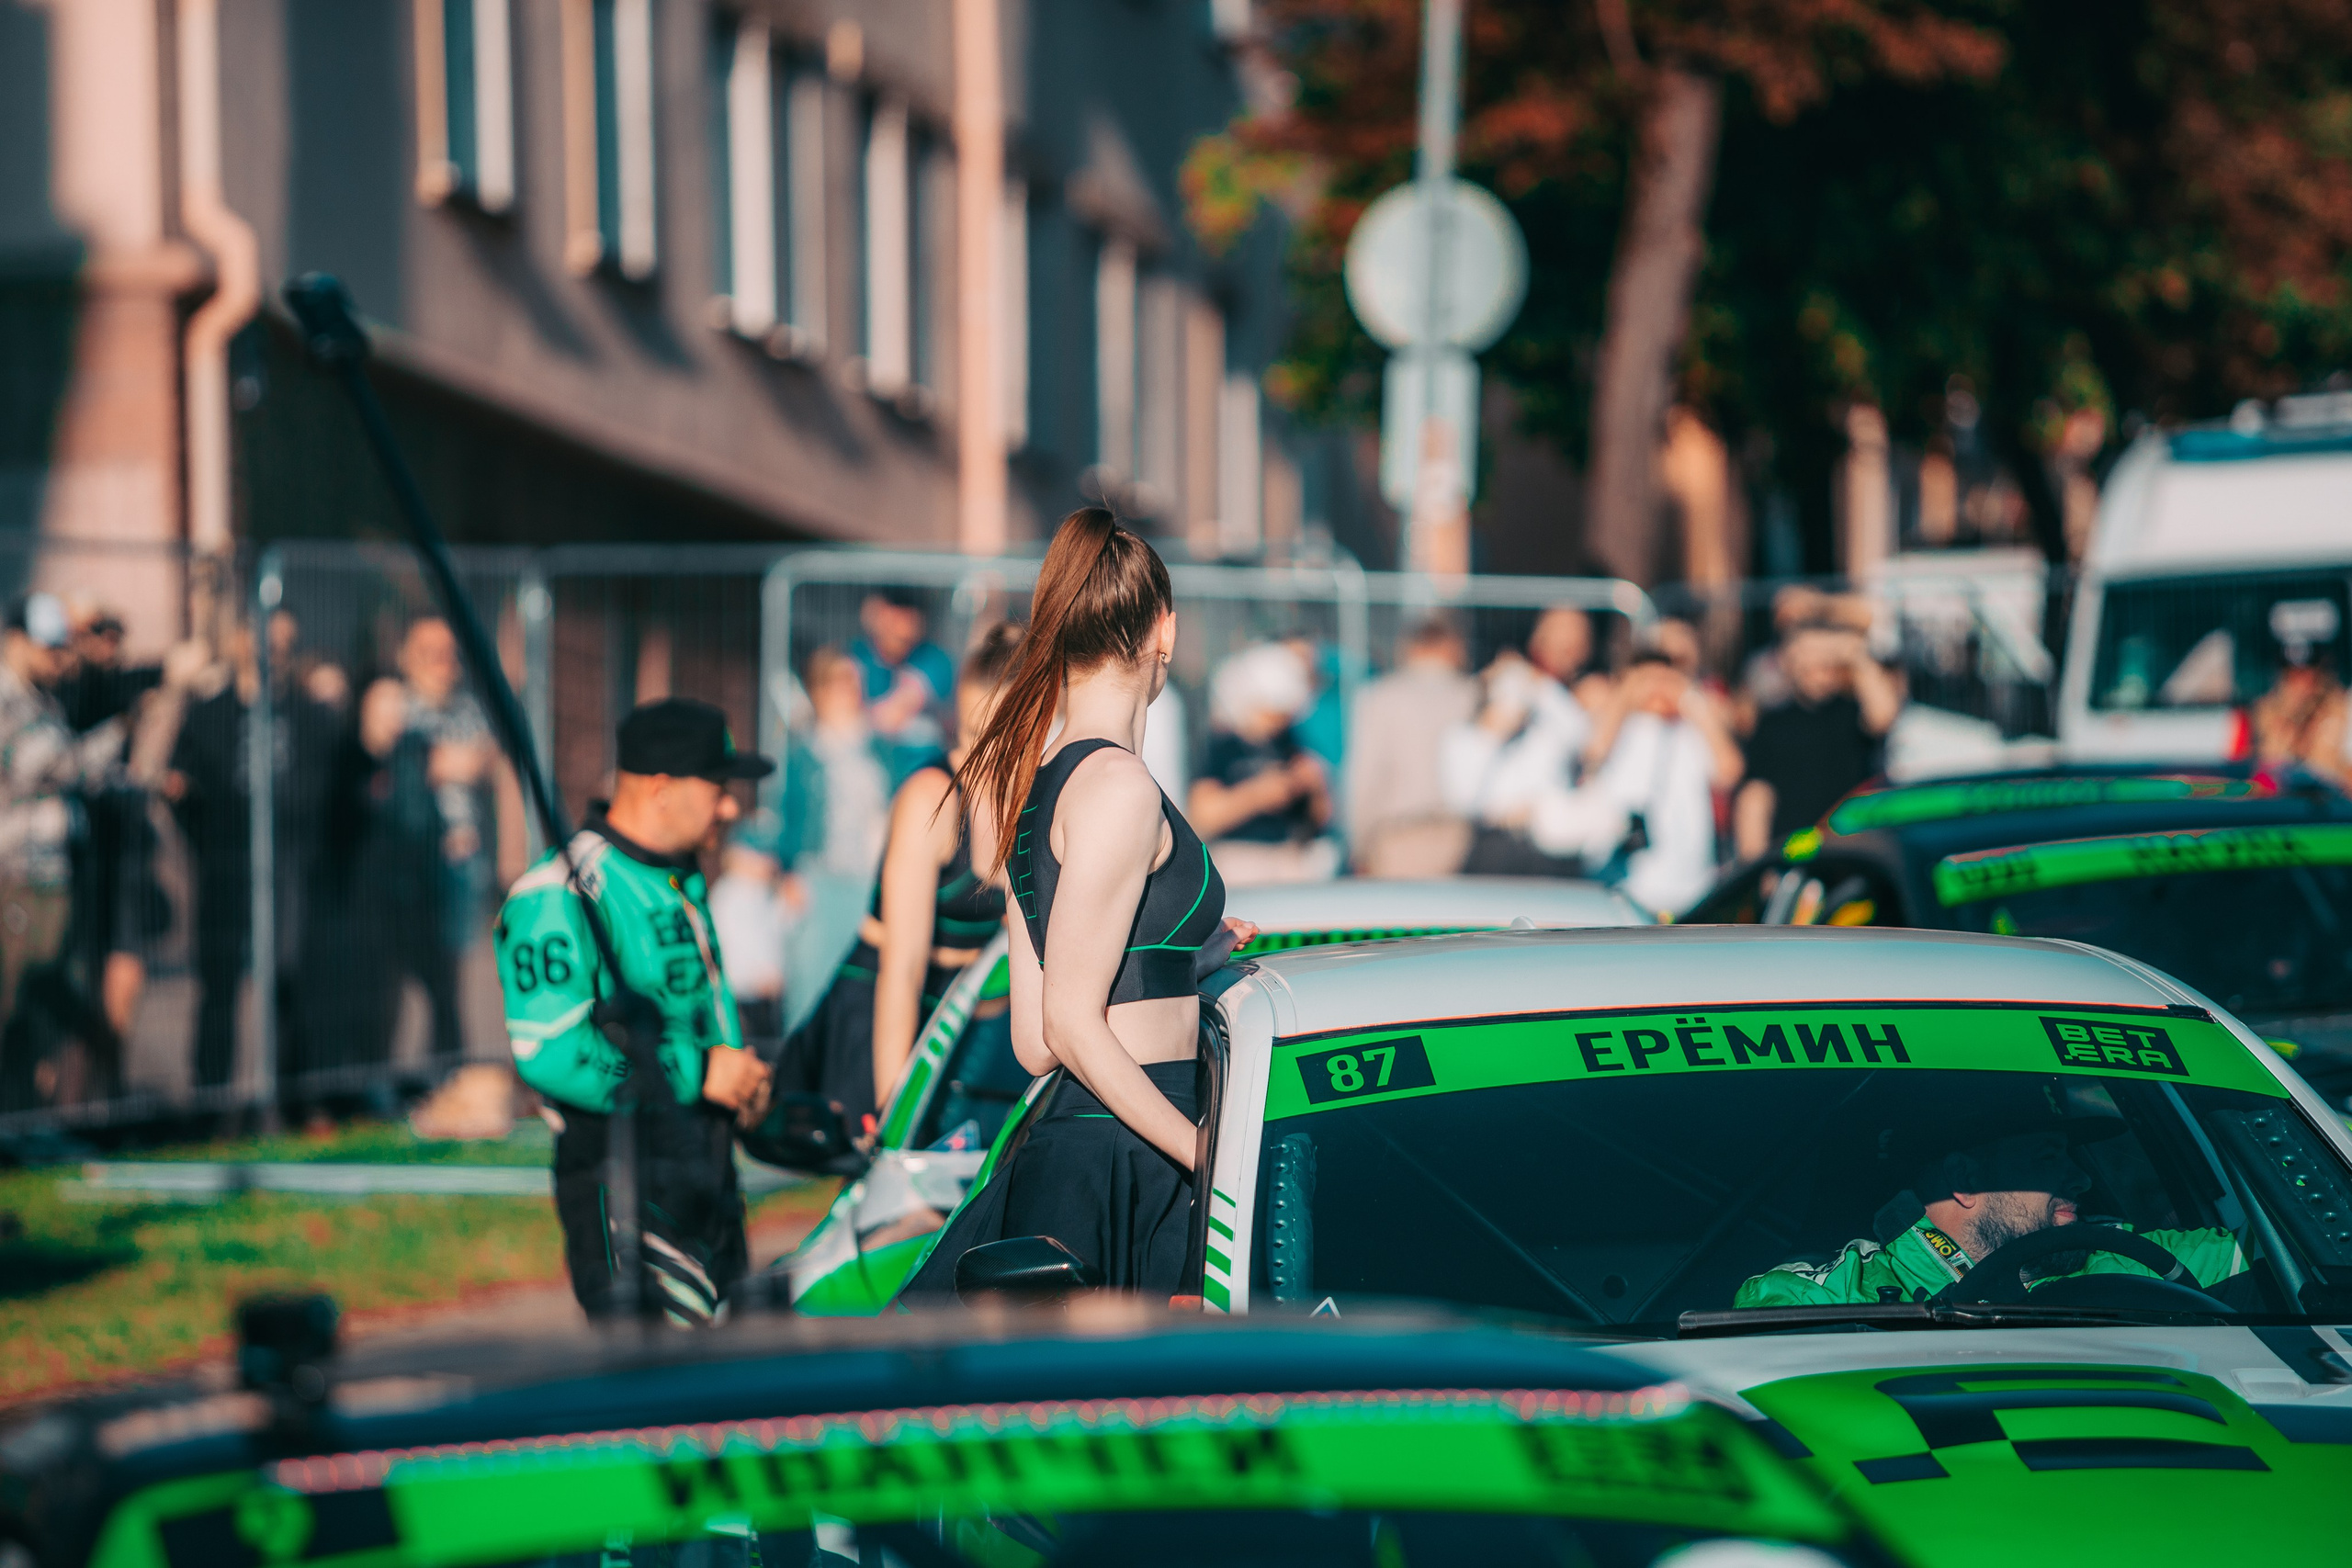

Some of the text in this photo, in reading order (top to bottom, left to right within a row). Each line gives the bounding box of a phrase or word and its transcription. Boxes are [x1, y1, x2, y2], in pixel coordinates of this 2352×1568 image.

[513, 933, 571, 993] 86
[2055, 1023, 2156, 1049] BET
[1326, 1017, 1912, 1092] 87 ЕРЁМИН
[2064, 1043, 2173, 1069] ERA
[1925, 1231, 1952, 1257] OMP
